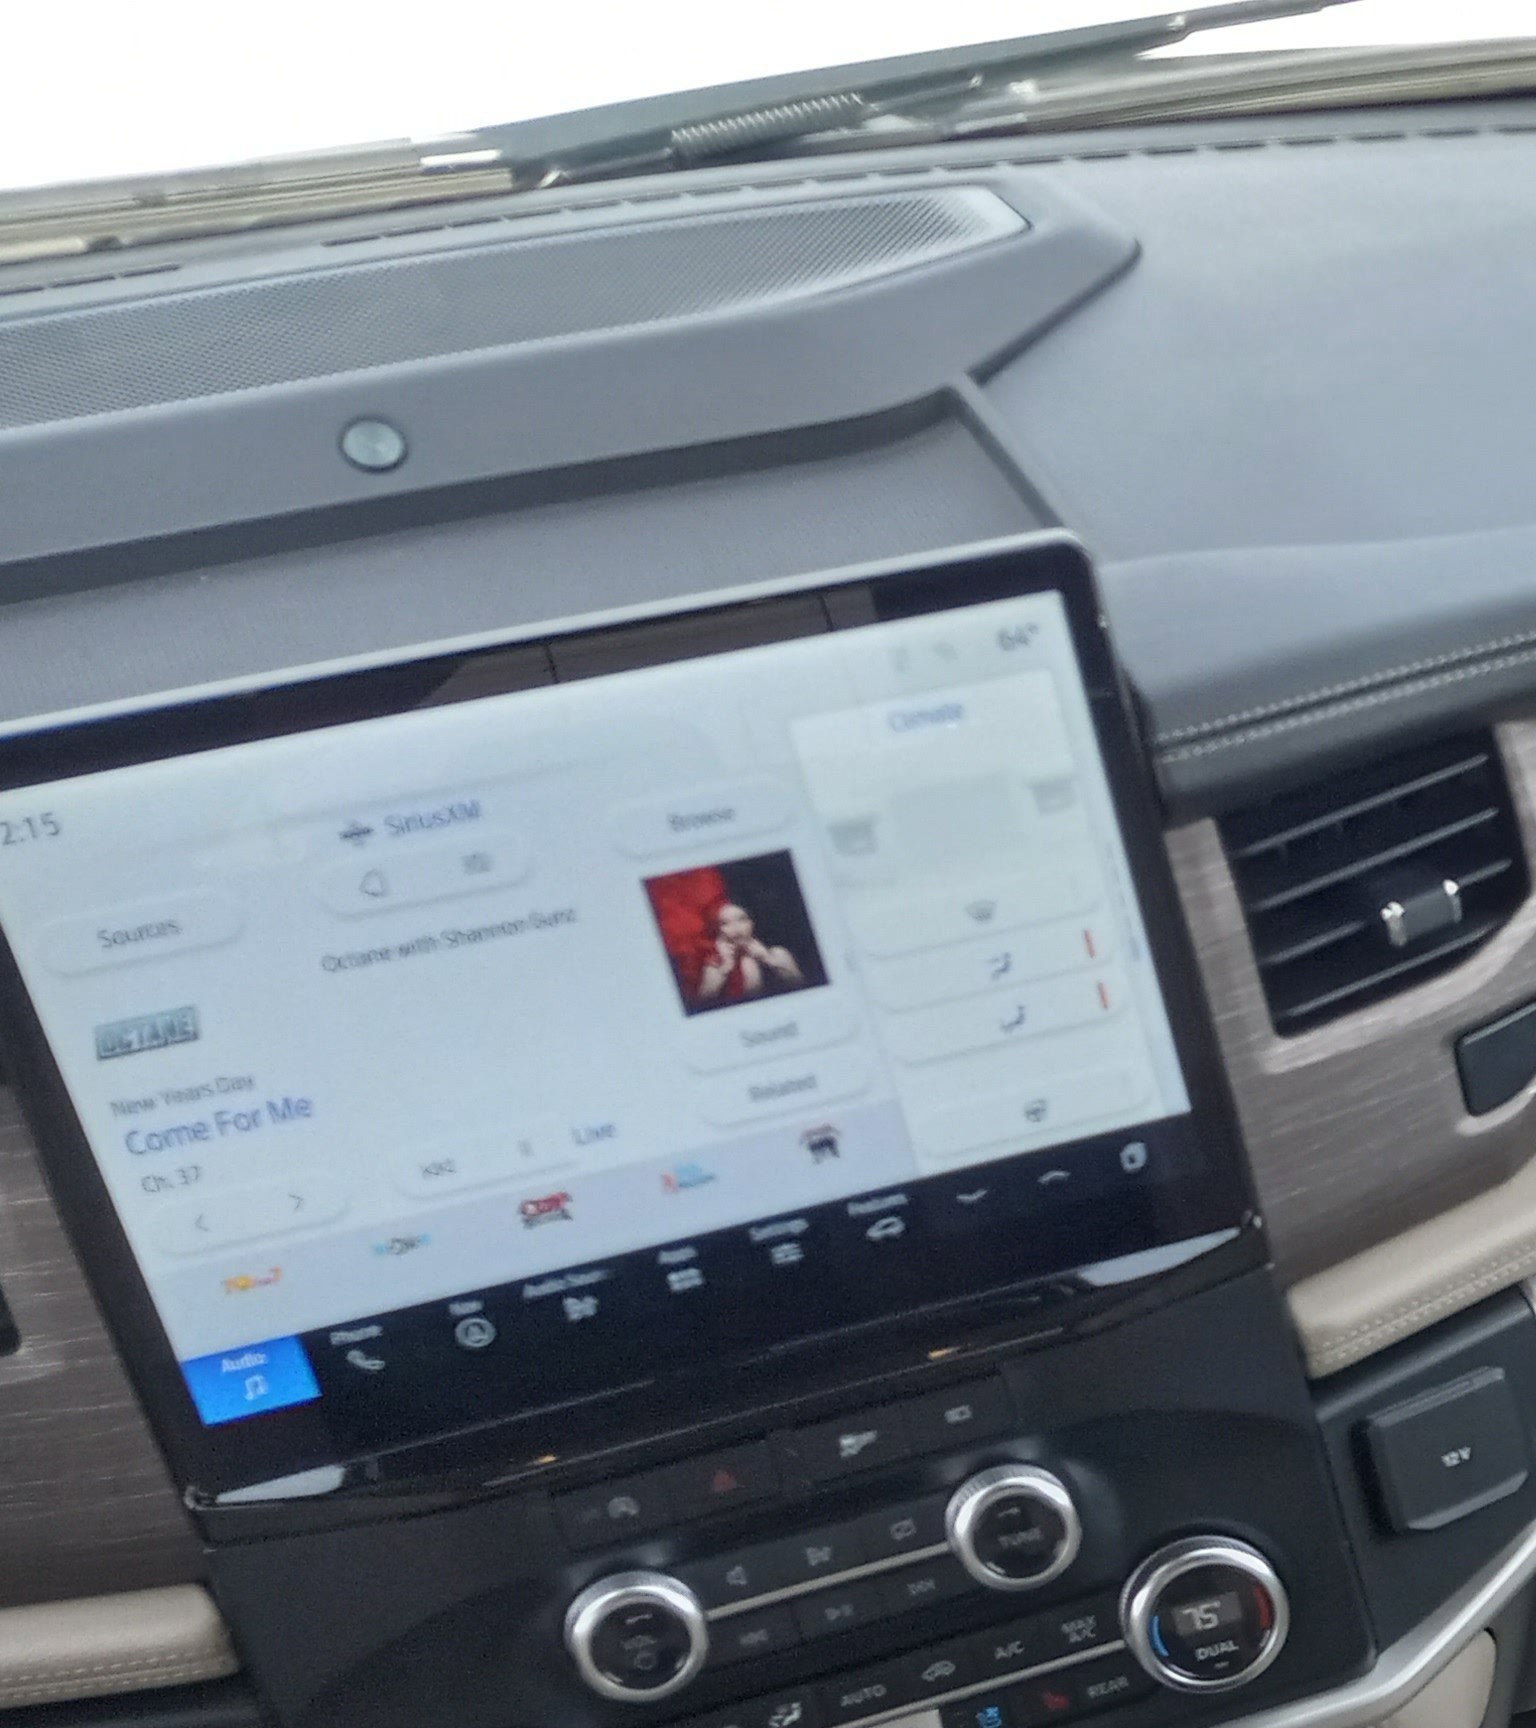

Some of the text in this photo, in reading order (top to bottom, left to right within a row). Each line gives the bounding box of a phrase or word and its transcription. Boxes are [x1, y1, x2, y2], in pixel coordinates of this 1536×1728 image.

[384, 801, 480, 837] SiriusXM
[97, 918, 182, 949] Sources
[125, 1097, 312, 1155] Come For Me
[1195, 1640, 1239, 1662] DUAL
